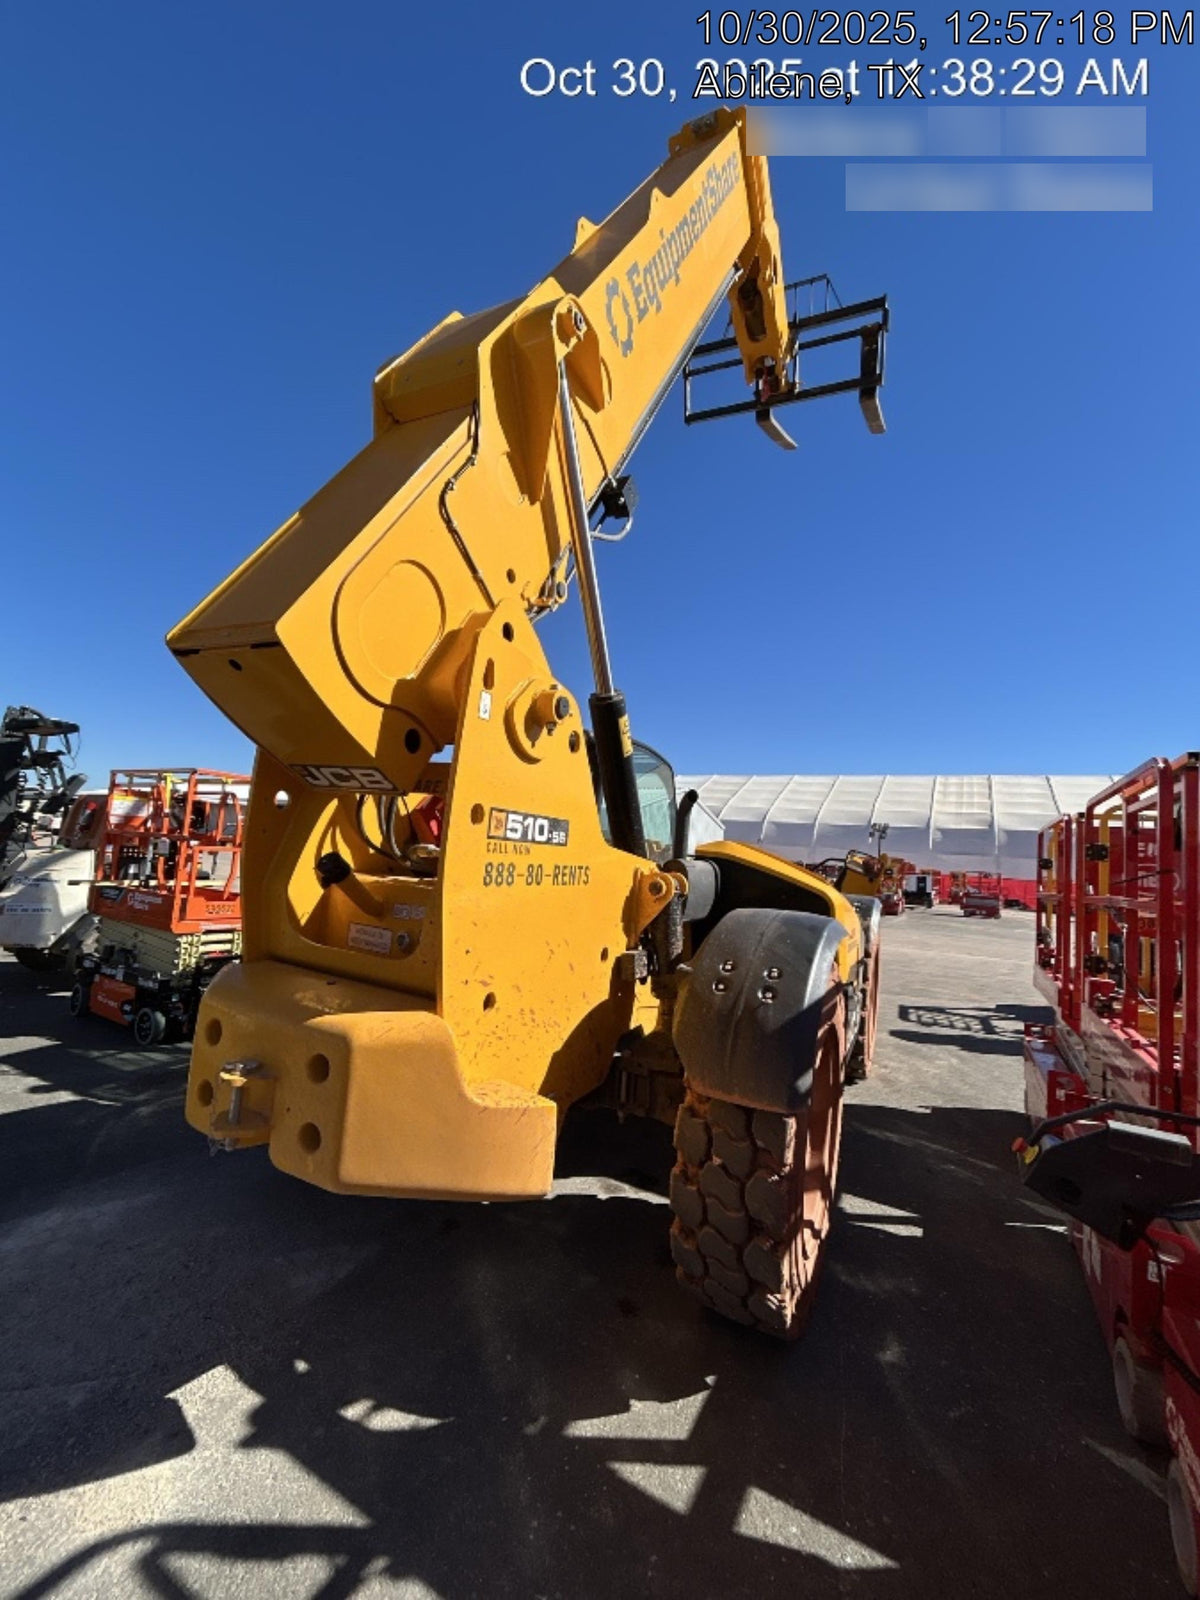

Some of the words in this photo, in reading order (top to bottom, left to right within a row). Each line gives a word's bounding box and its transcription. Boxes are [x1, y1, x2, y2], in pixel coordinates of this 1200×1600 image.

[626, 151, 741, 323] EquipmentShare
[304, 765, 394, 790] JCB
[487, 842, 508, 854] CALL
[483, 862, 590, 887] 888-80-RENTS
